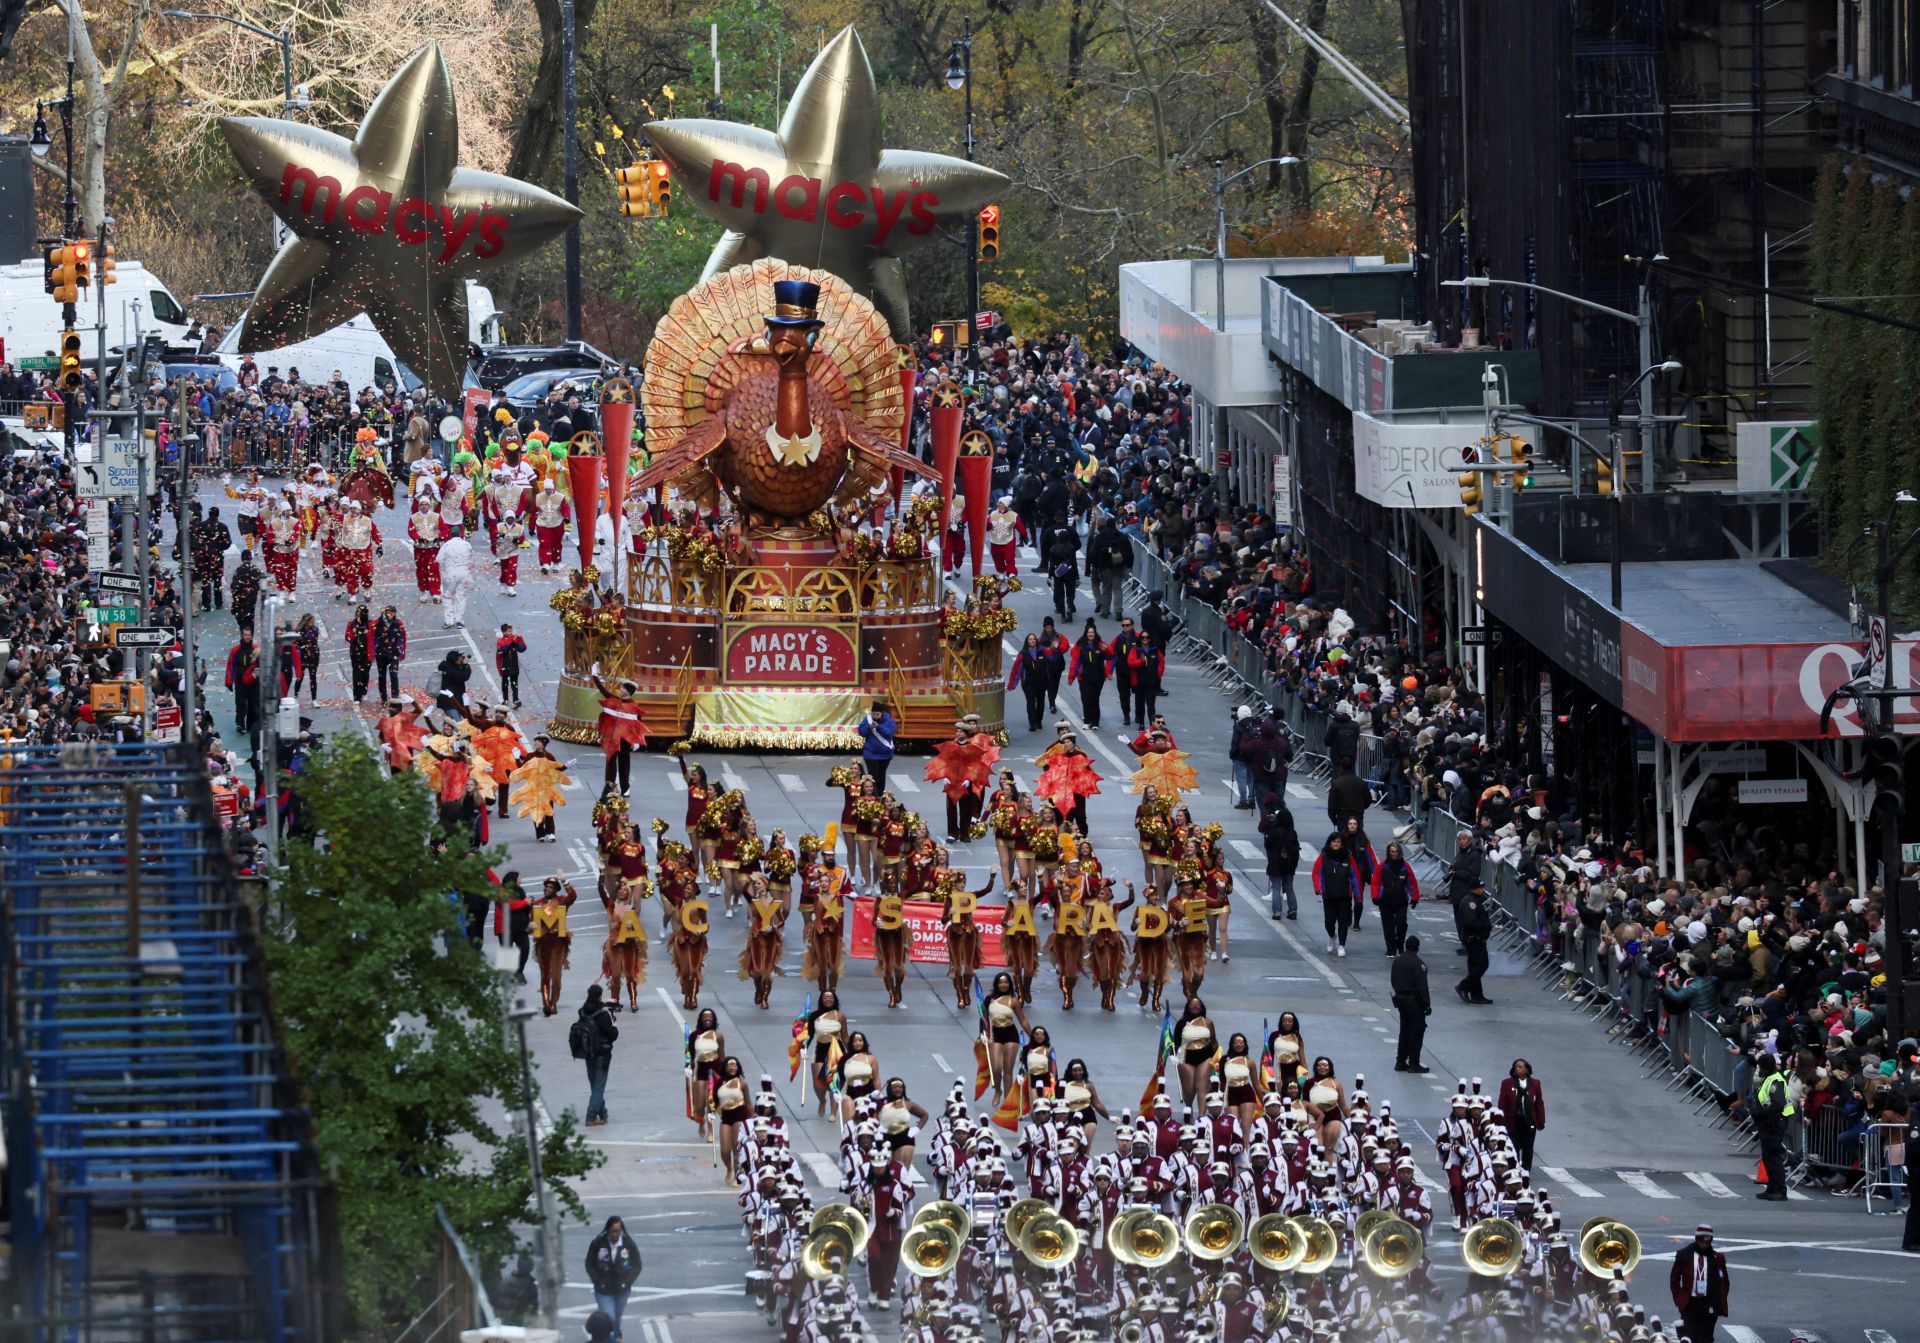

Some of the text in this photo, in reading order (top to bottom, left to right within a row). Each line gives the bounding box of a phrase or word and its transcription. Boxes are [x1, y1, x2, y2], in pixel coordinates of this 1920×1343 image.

[114, 442, 138, 453] NYP
[1423, 478, 1455, 487] SALON
[107, 577, 123, 587] ONE
[100, 611, 109, 621] W
[114, 610, 126, 621] 58
[121, 633, 167, 642] ONE WAY
[751, 629, 828, 653] MACY'S
[745, 654, 833, 674] PARADE
[1740, 788, 1772, 796] QUALITY
